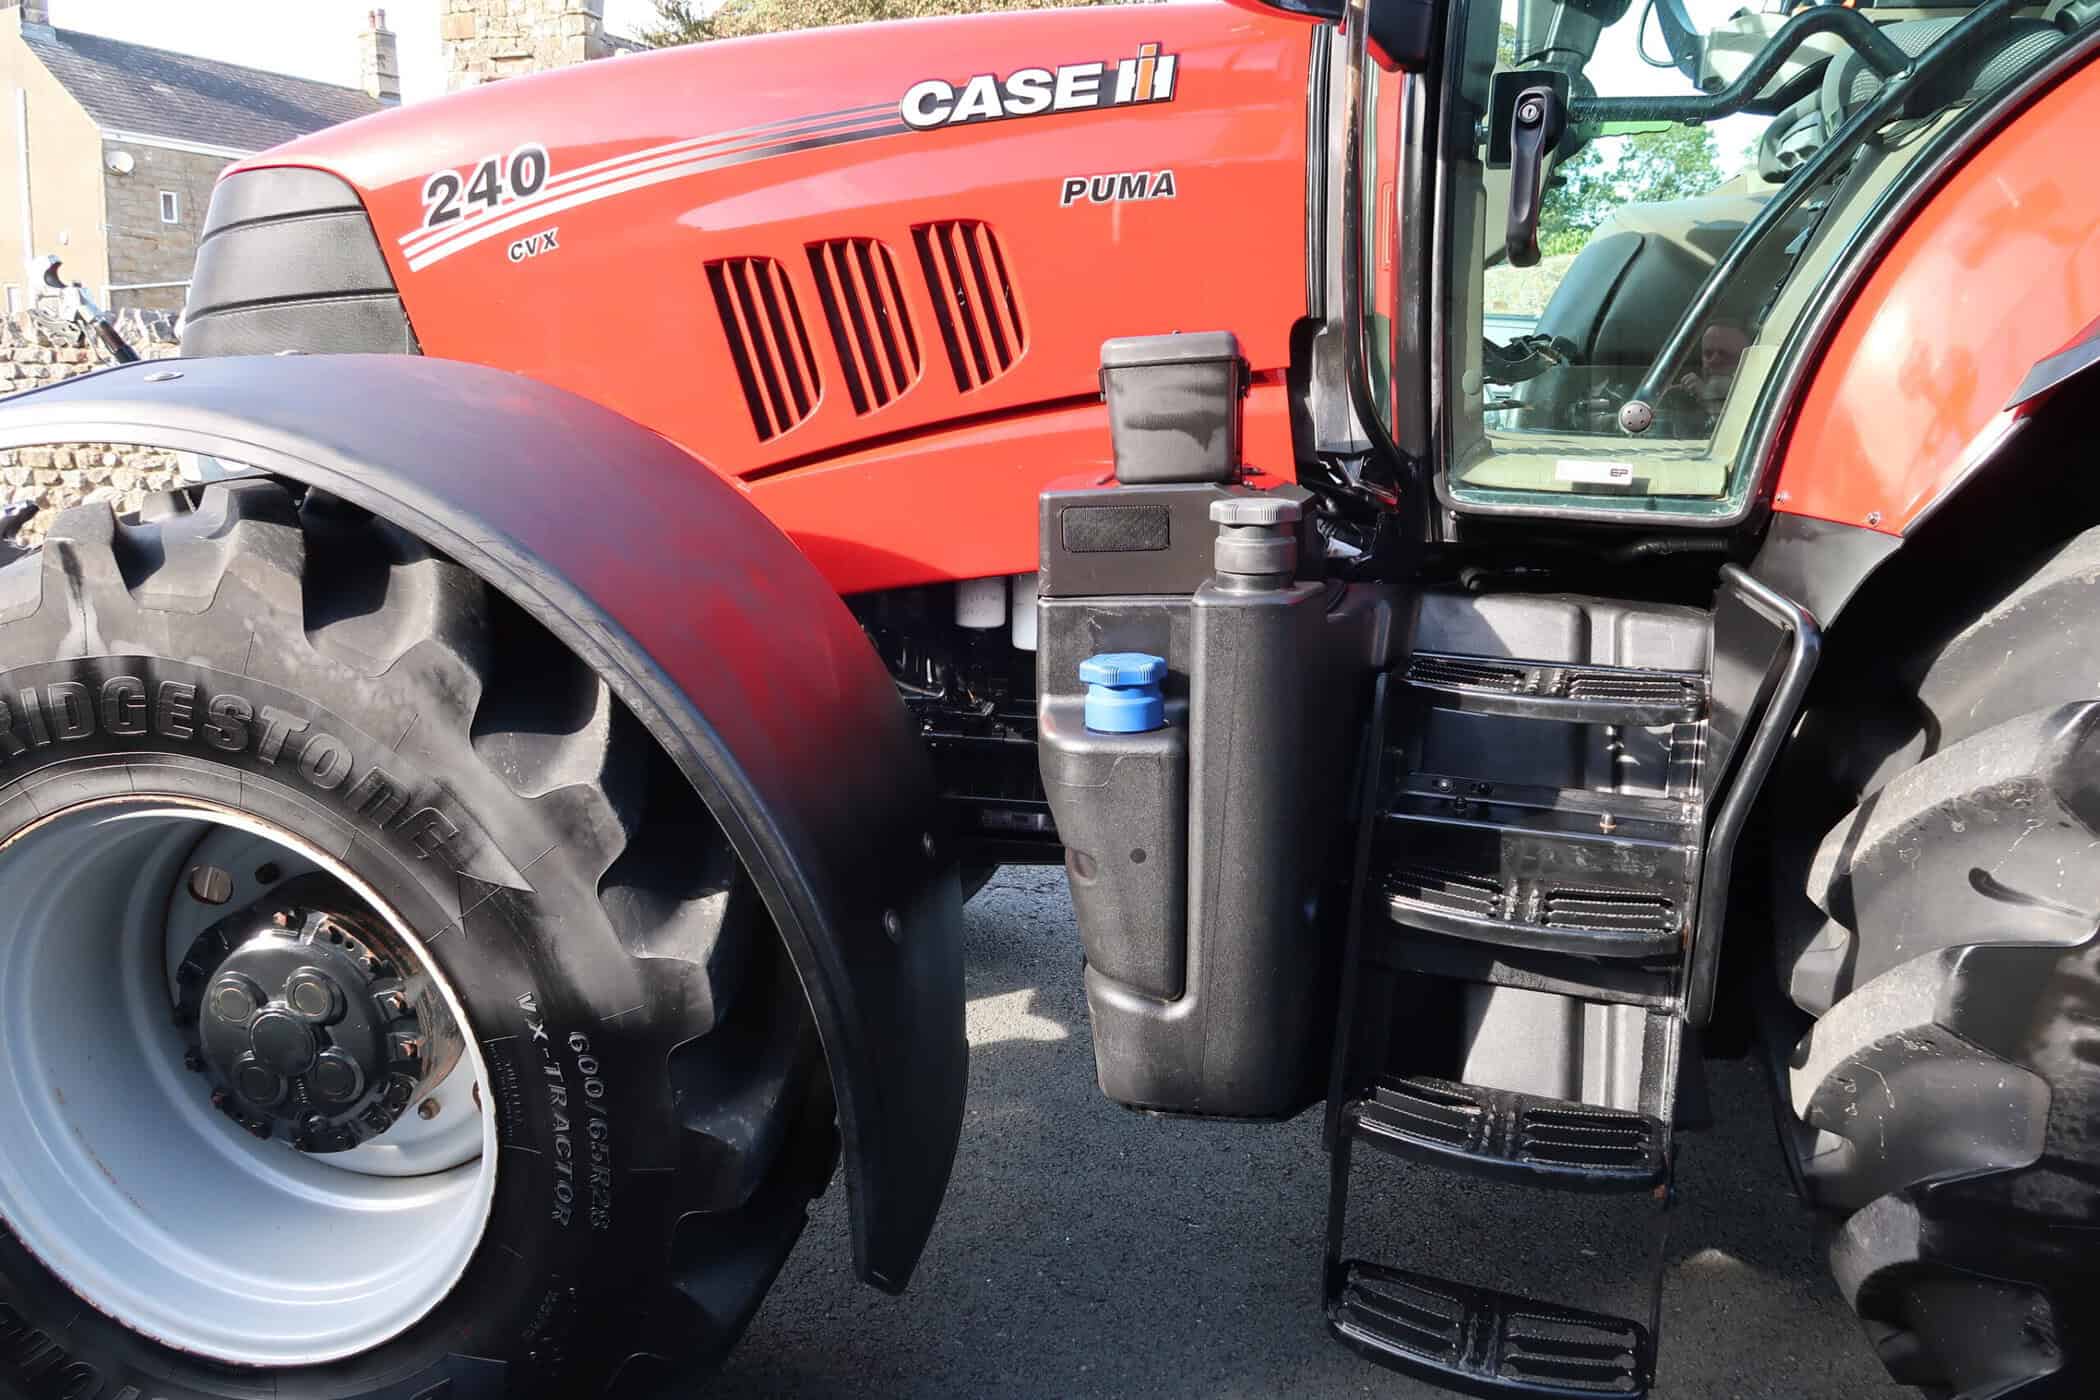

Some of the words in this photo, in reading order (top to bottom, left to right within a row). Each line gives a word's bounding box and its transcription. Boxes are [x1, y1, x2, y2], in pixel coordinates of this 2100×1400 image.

[901, 60, 1105, 129] CASE
[425, 144, 548, 228] 240
[1062, 171, 1176, 205] PUMA
[509, 229, 558, 261] CVX
